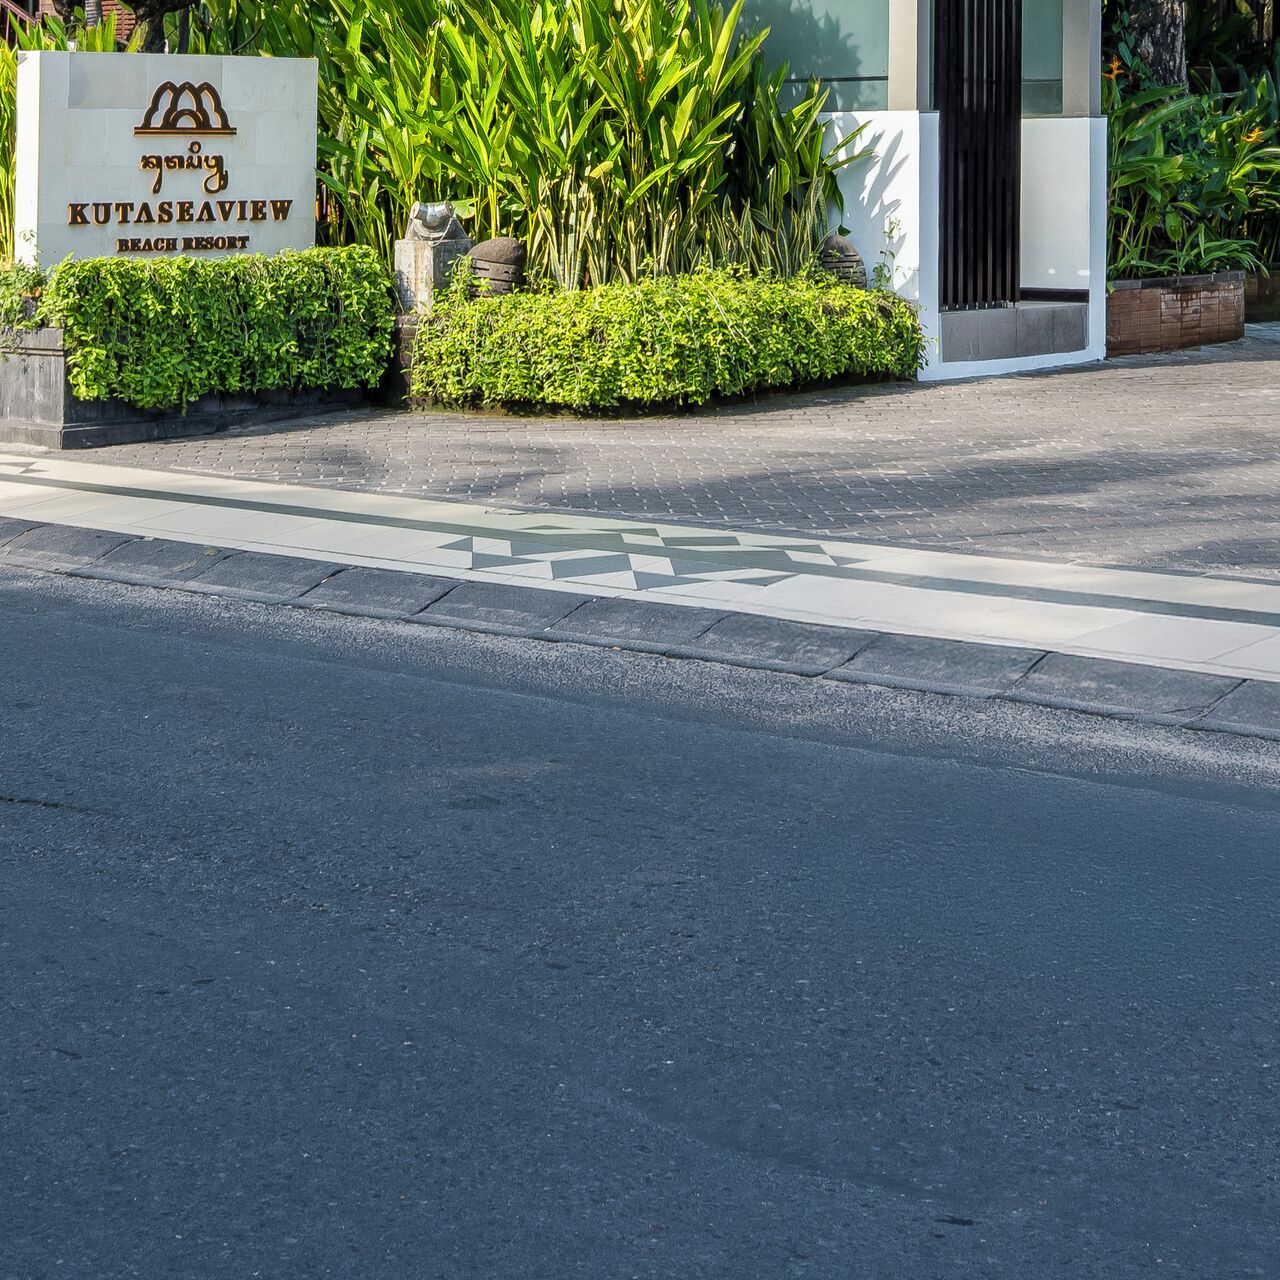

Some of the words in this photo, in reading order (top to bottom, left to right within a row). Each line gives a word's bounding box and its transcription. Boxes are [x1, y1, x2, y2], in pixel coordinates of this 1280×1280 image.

[68, 199, 294, 226] KUTASEAVIEW
[116, 237, 179, 253] BEACH
[181, 235, 250, 251] RESORT
